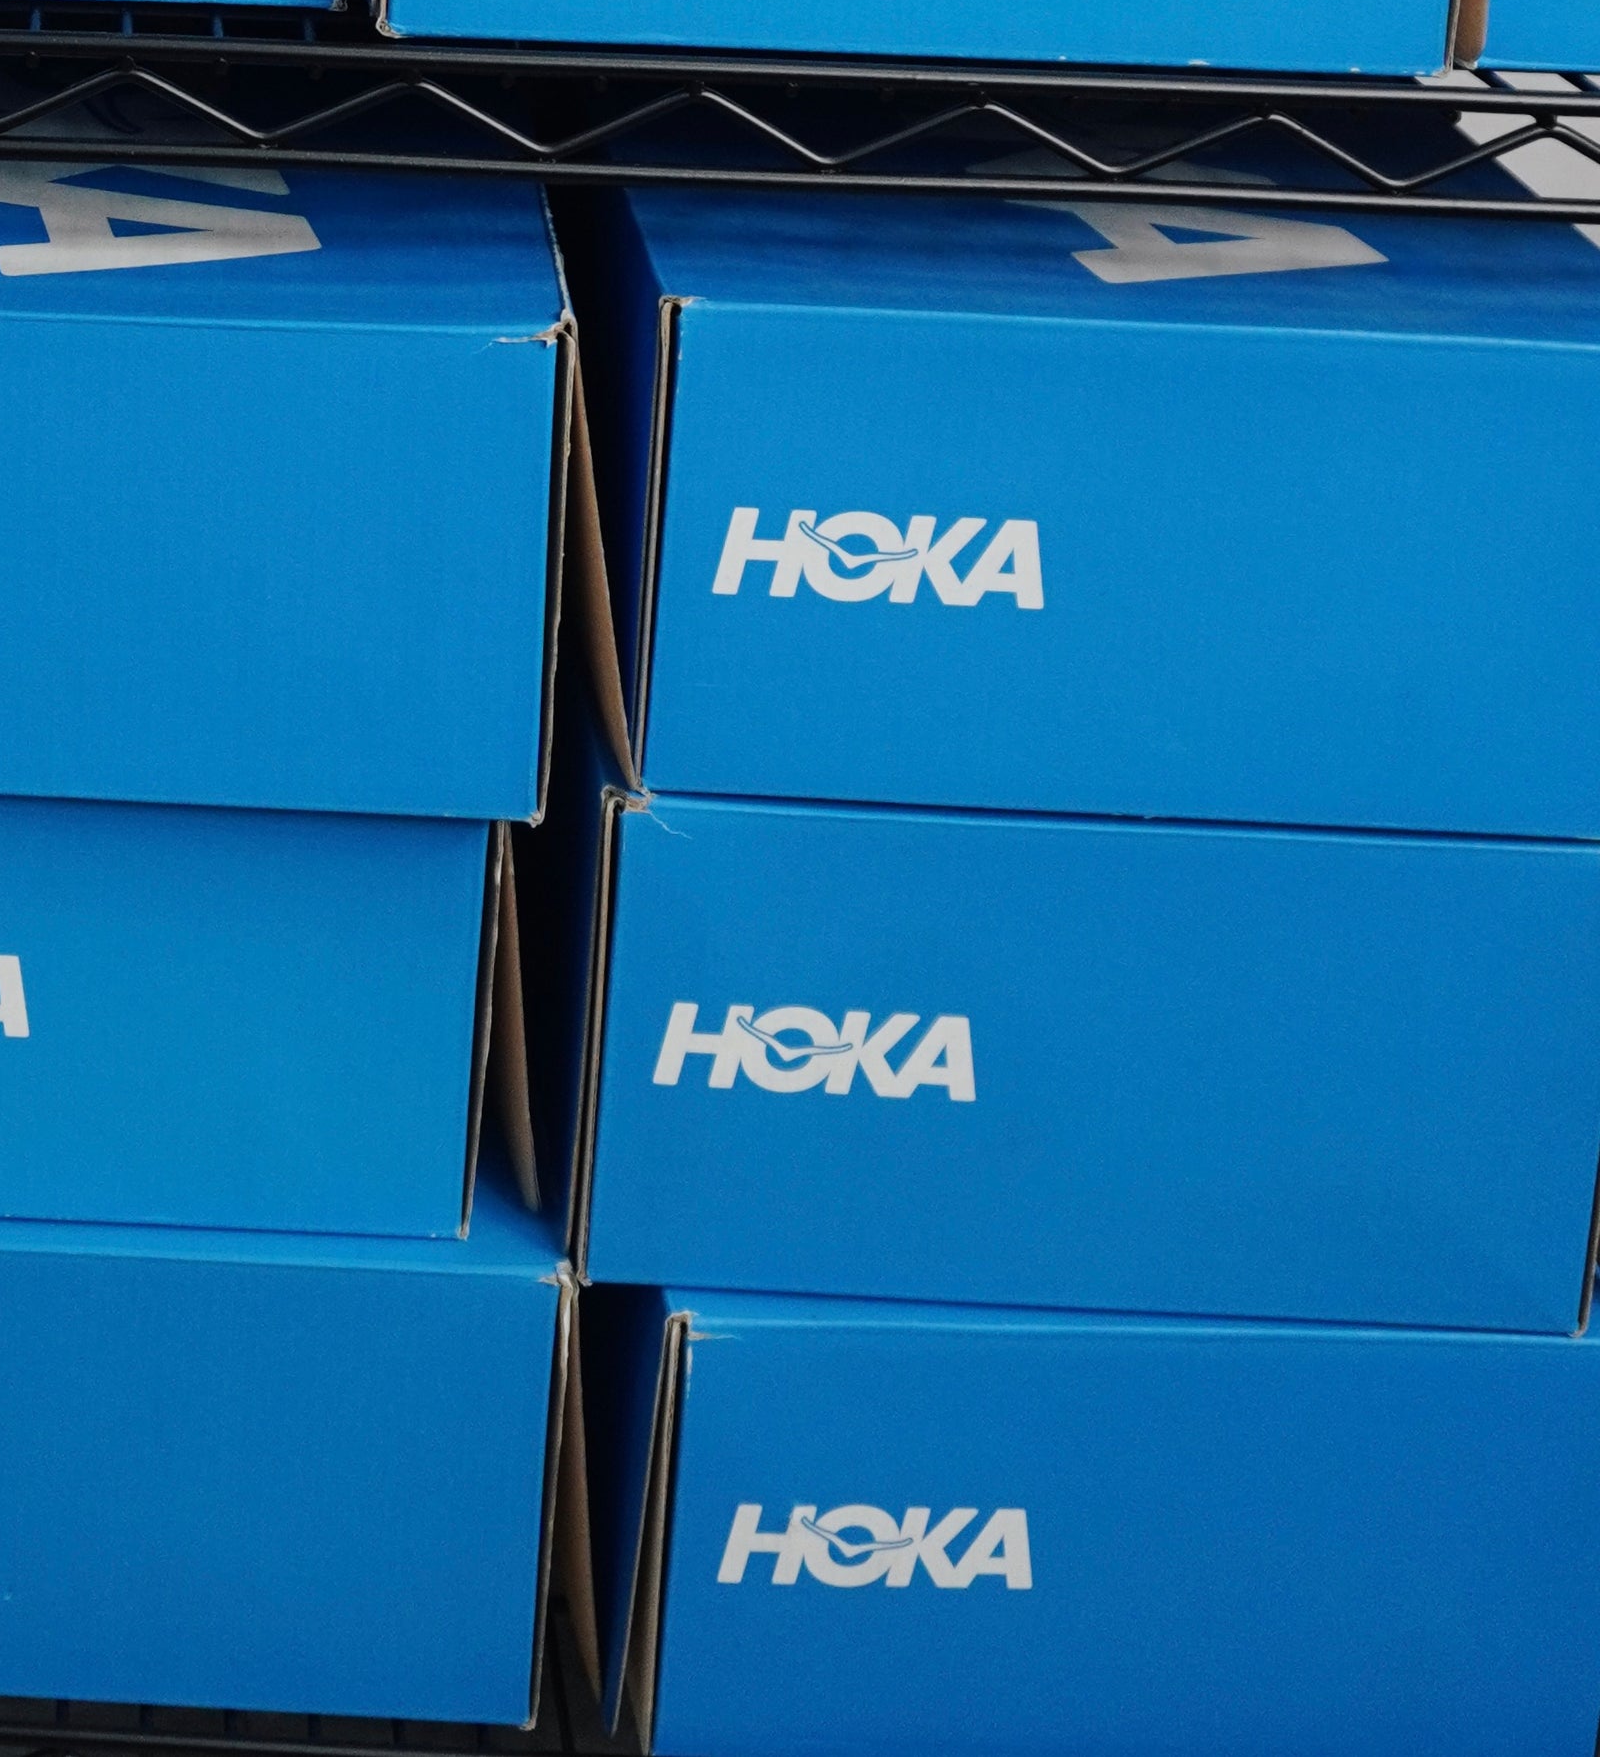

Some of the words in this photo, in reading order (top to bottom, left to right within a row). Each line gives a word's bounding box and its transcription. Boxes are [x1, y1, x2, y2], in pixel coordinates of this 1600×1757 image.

[712, 507, 1044, 610] HOKA
[653, 1002, 976, 1102] HOKA
[717, 1504, 1032, 1589] HOKA
